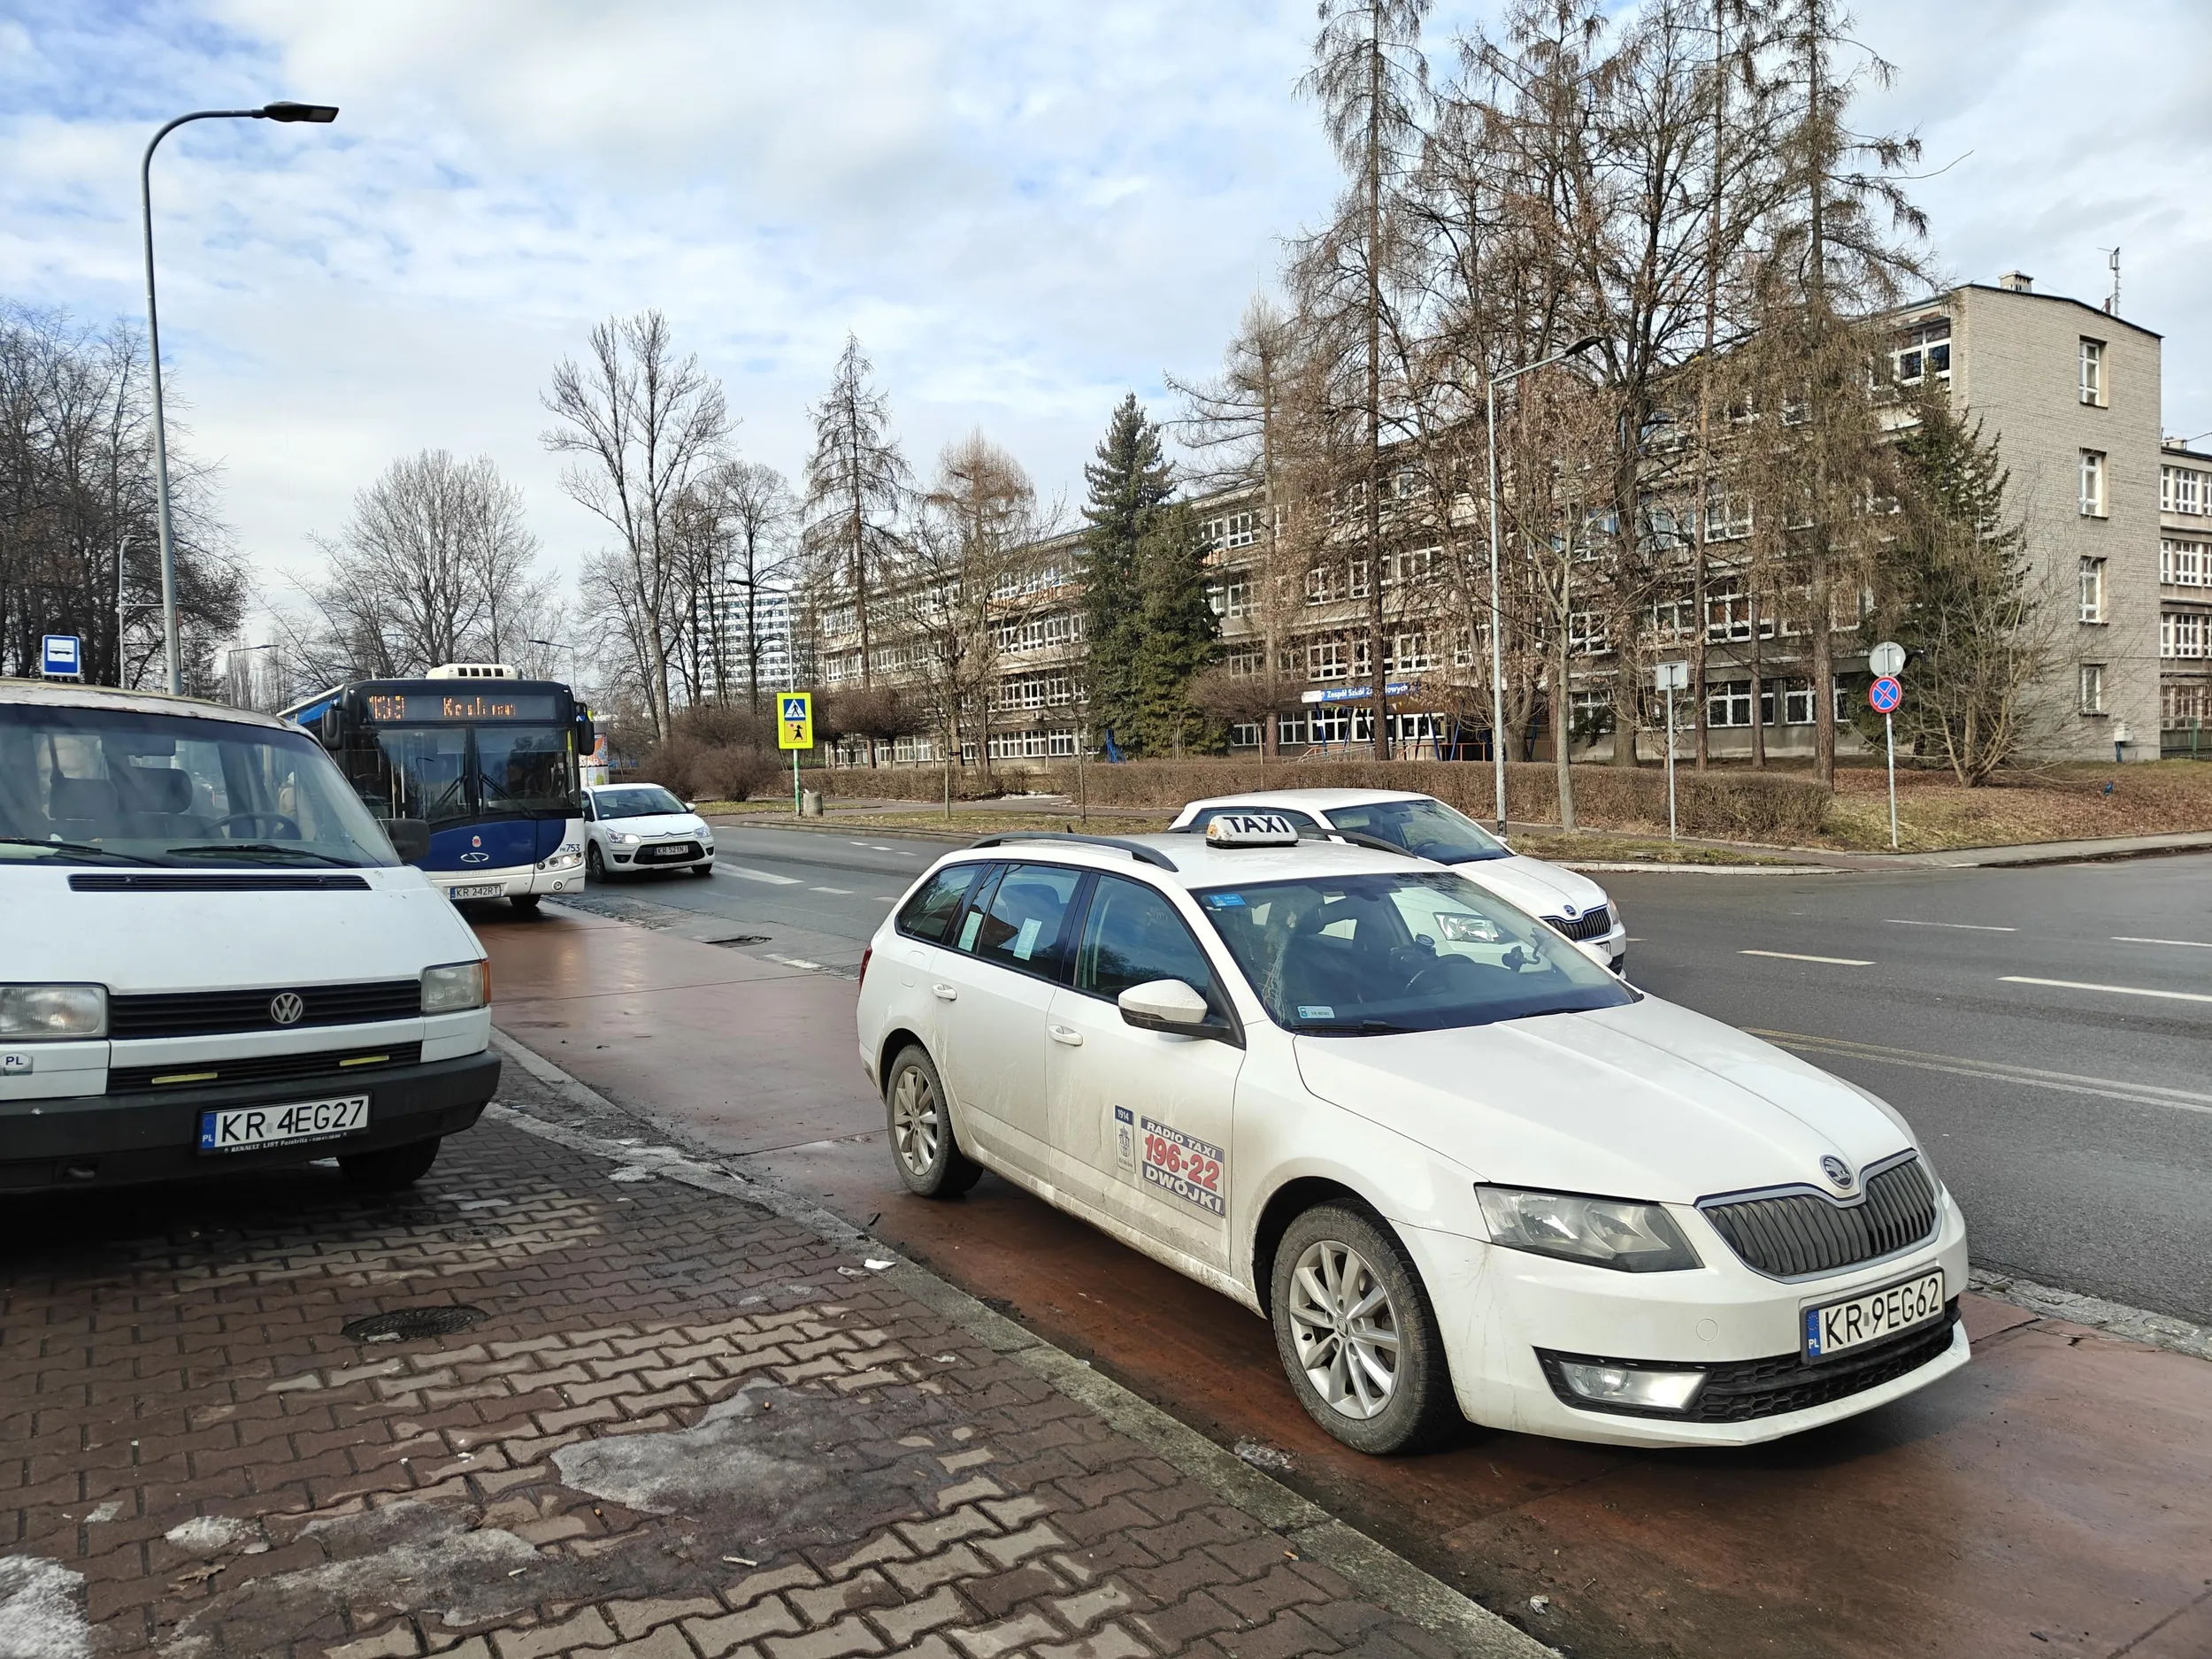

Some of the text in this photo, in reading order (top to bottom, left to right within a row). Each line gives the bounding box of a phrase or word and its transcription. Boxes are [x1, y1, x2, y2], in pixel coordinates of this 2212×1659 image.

[1222, 816, 1290, 833] TAXI
[456, 886, 499, 897] KR 242RT
[5, 1056, 24, 1065] PL
[221, 1099, 365, 1143] KR 4EG27
[1118, 1109, 1130, 1122] 1914
[202, 1134, 213, 1143] PL
[1147, 1121, 1217, 1159] RADIO TAXI
[231, 1143, 260, 1152] RENAULT
[1144, 1133, 1220, 1192] 196-22
[1146, 1164, 1222, 1213] DWÓJKI
[1824, 1277, 1939, 1348] KR 9EG62
[1808, 1338, 1820, 1349] PL
